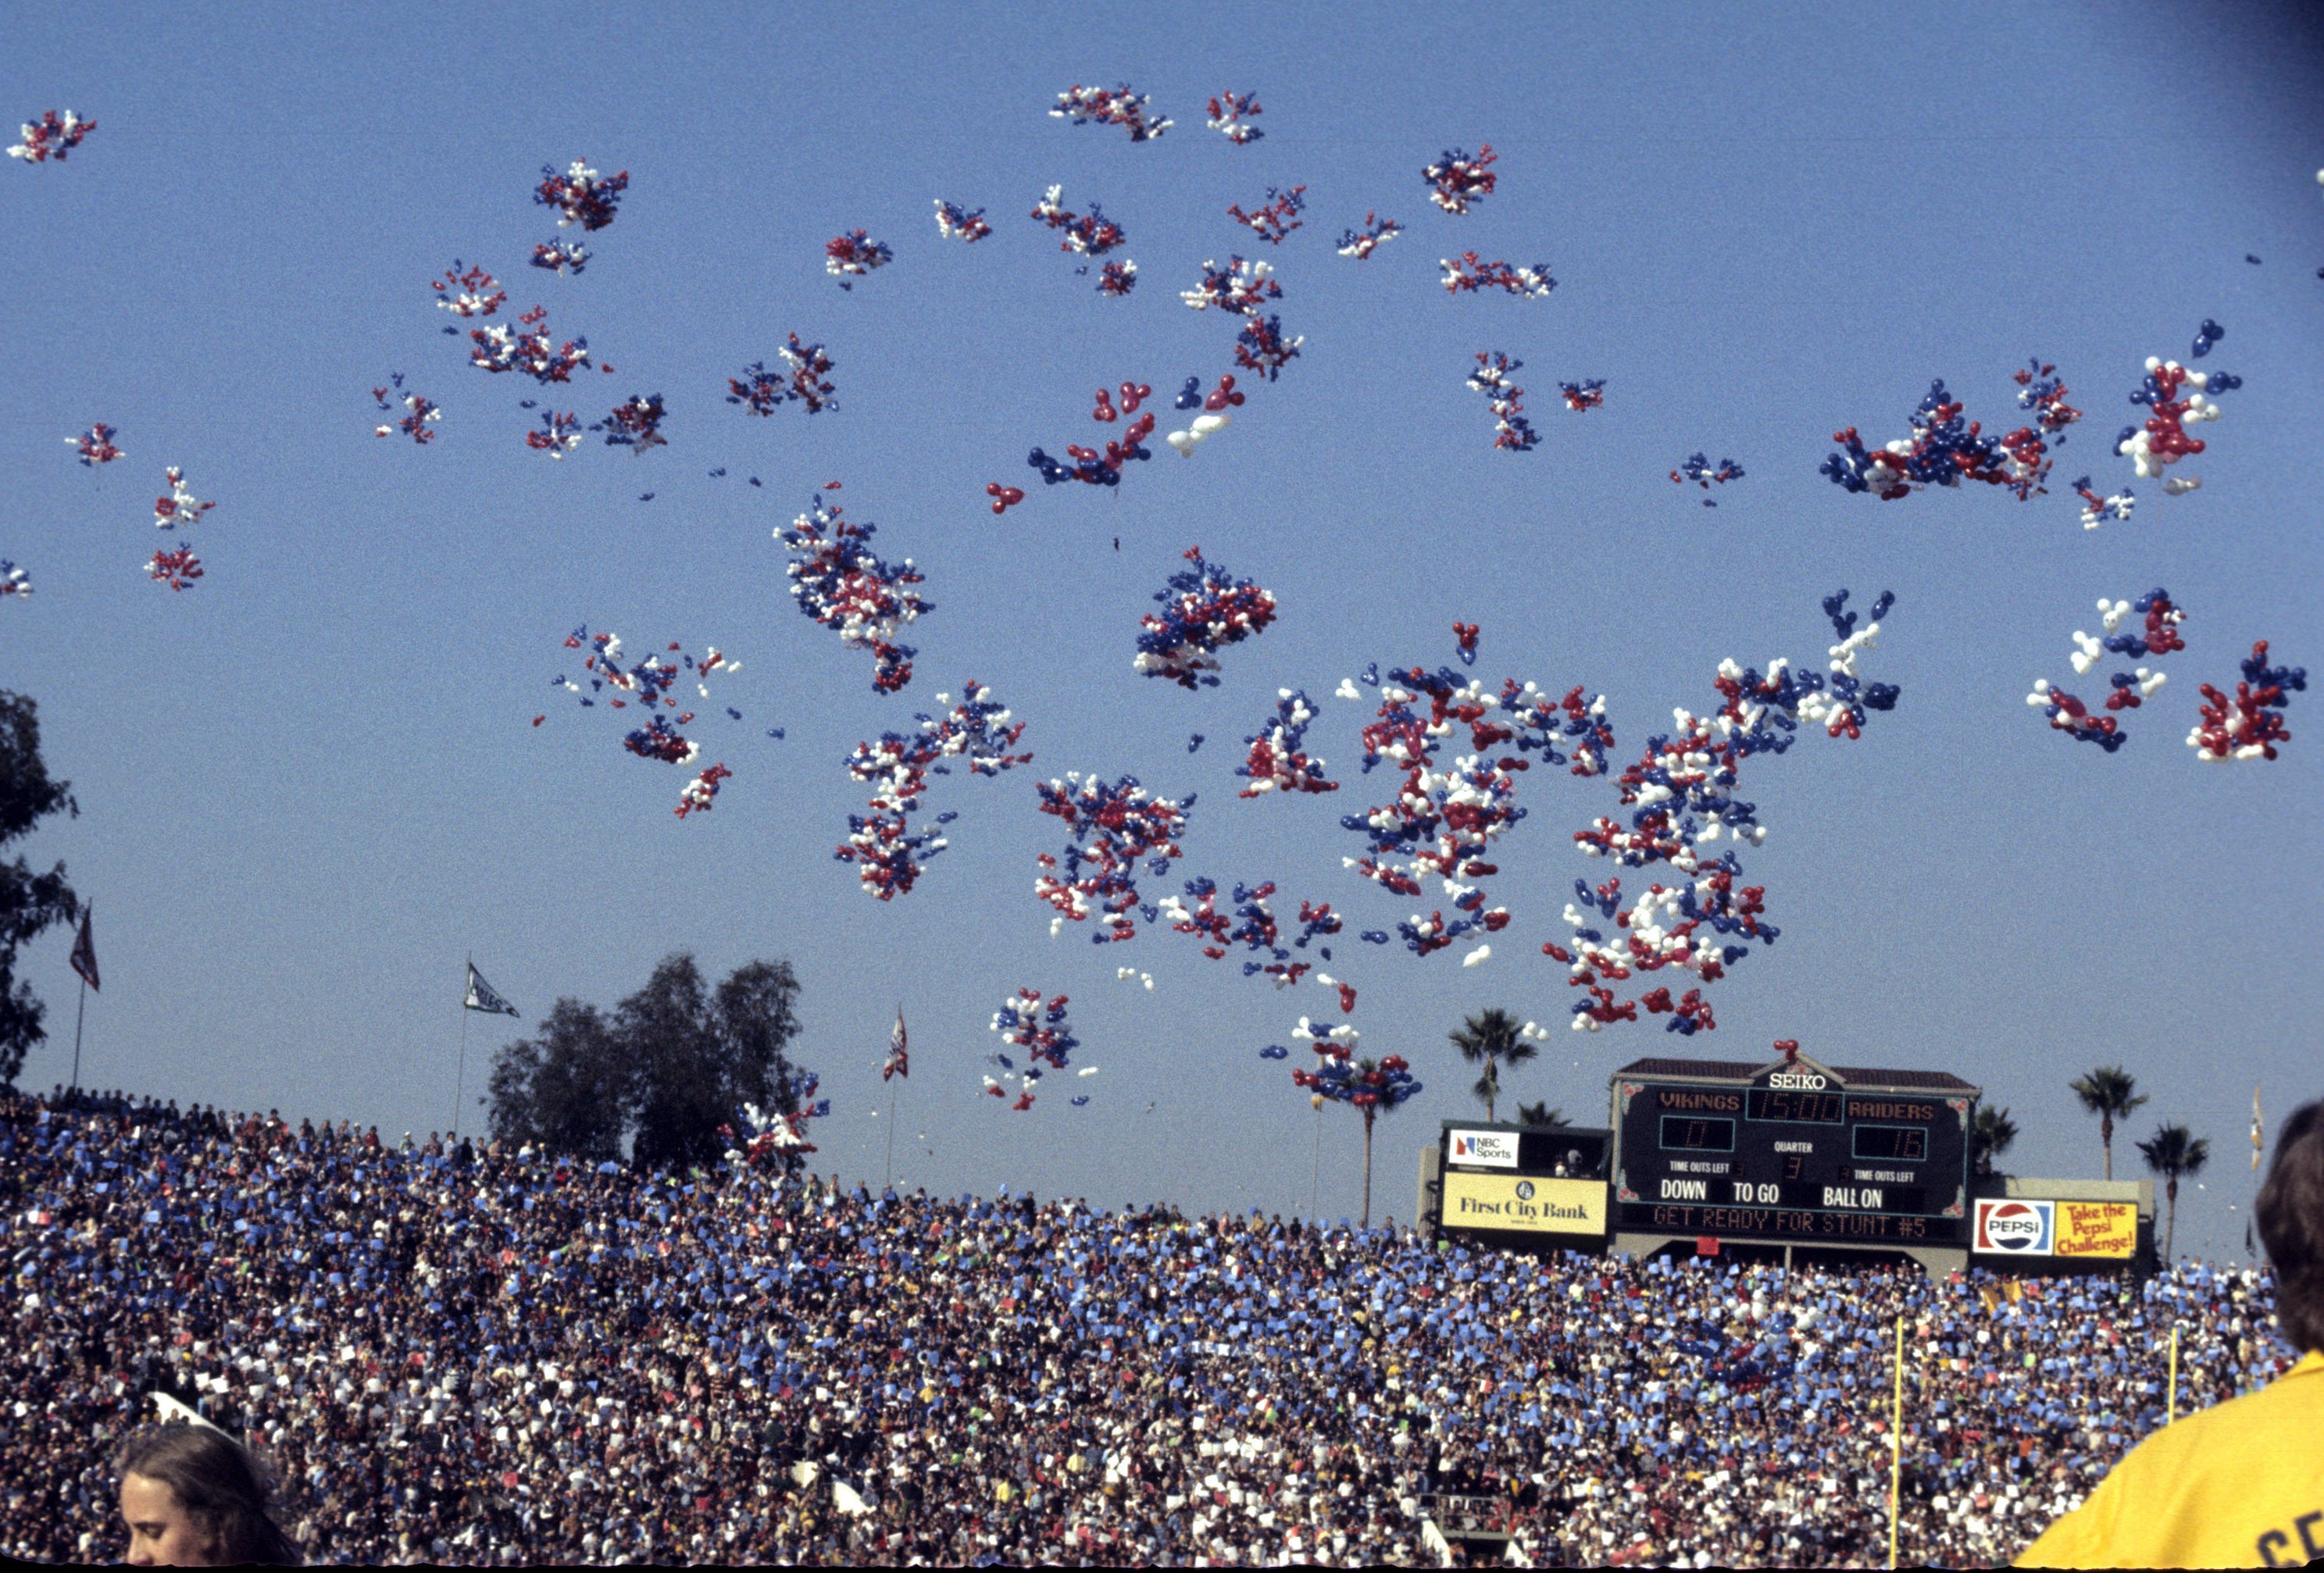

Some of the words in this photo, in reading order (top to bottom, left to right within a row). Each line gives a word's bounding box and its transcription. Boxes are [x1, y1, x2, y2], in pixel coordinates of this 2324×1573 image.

[1769, 1072, 1826, 1090] SEIKO
[1660, 1092, 1740, 1111] VIKINGS
[1848, 1101, 1934, 1120] RAIDERS
[1476, 1137, 1500, 1148] NBC
[1685, 1120, 1708, 1147] 0
[1476, 1147, 1512, 1159] Sports
[1774, 1140, 1813, 1154] QUARTER
[1669, 1161, 1689, 1172] TIME
[1690, 1161, 1711, 1173] OUTS
[1712, 1162, 1730, 1174] LEFT
[1855, 1169, 1873, 1181] TIME
[1875, 1171, 1895, 1182] OUTS
[1897, 1172, 1915, 1182] LEFT
[1661, 1179, 1707, 1200] DOWN
[1733, 1182, 1754, 1202] TO
[1758, 1183, 1780, 1204] GO
[1823, 1186, 1858, 1207] BALL
[1861, 1188, 1883, 1208] ON
[1460, 1197, 1501, 1215] First
[1505, 1200, 1538, 1219] City
[1543, 1202, 1589, 1220] Bank
[2066, 1204, 2101, 1221] Take
[2104, 1203, 2126, 1218] the
[1654, 1206, 1694, 1225] GET
[1703, 1208, 1769, 1229] READY
[1776, 1211, 1814, 1232] FOR
[1823, 1213, 1890, 1236] STUNT
[1899, 1218, 1926, 1238] #5
[2072, 1218, 2112, 1238] Pepsi
[2057, 1230, 2133, 1254] Challenge!
